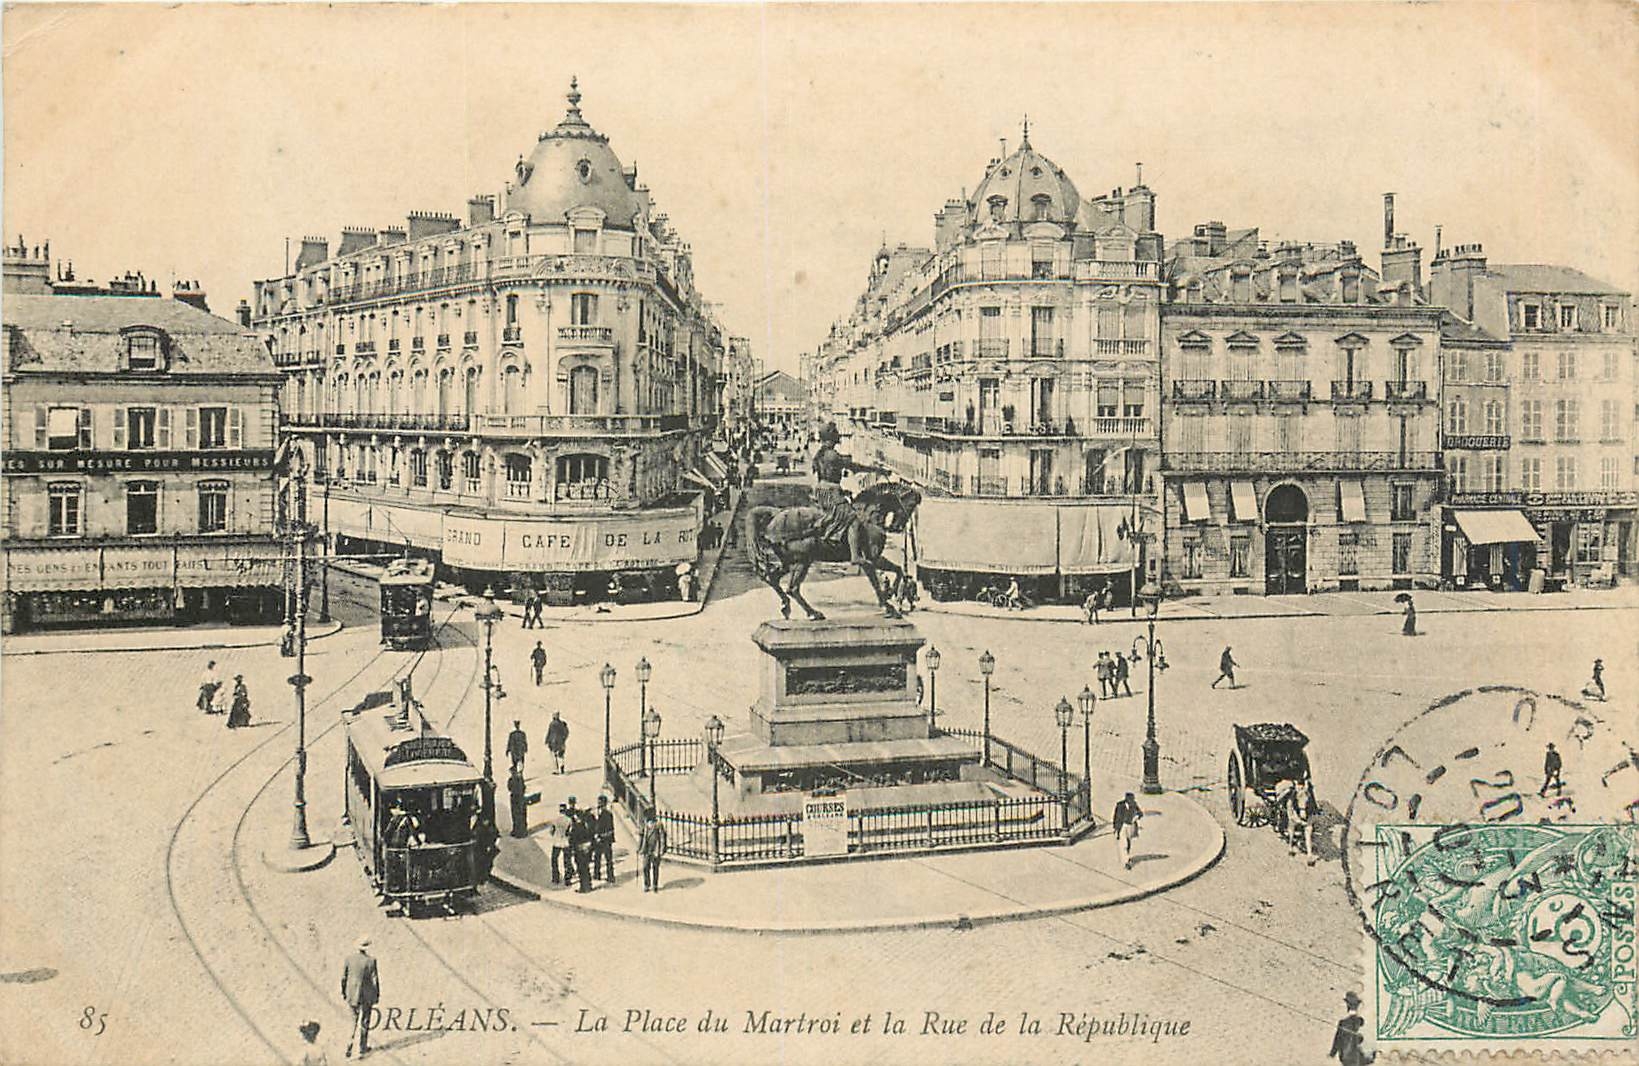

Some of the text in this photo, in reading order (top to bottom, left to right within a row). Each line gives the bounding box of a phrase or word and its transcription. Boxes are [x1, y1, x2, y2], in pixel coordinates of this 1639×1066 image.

[1447, 436, 1509, 448] DROGUERIE
[39, 460, 64, 469] SUR
[77, 459, 132, 469] MESURE
[144, 458, 179, 468] POUR
[191, 457, 269, 468] MESSIEURS
[522, 534, 571, 549] CAFE
[605, 533, 628, 547] DE
[643, 531, 662, 545] LA
[85, 560, 138, 573] ENANTS
[142, 561, 168, 571] TOUT
[805, 802, 845, 814] COURSES
